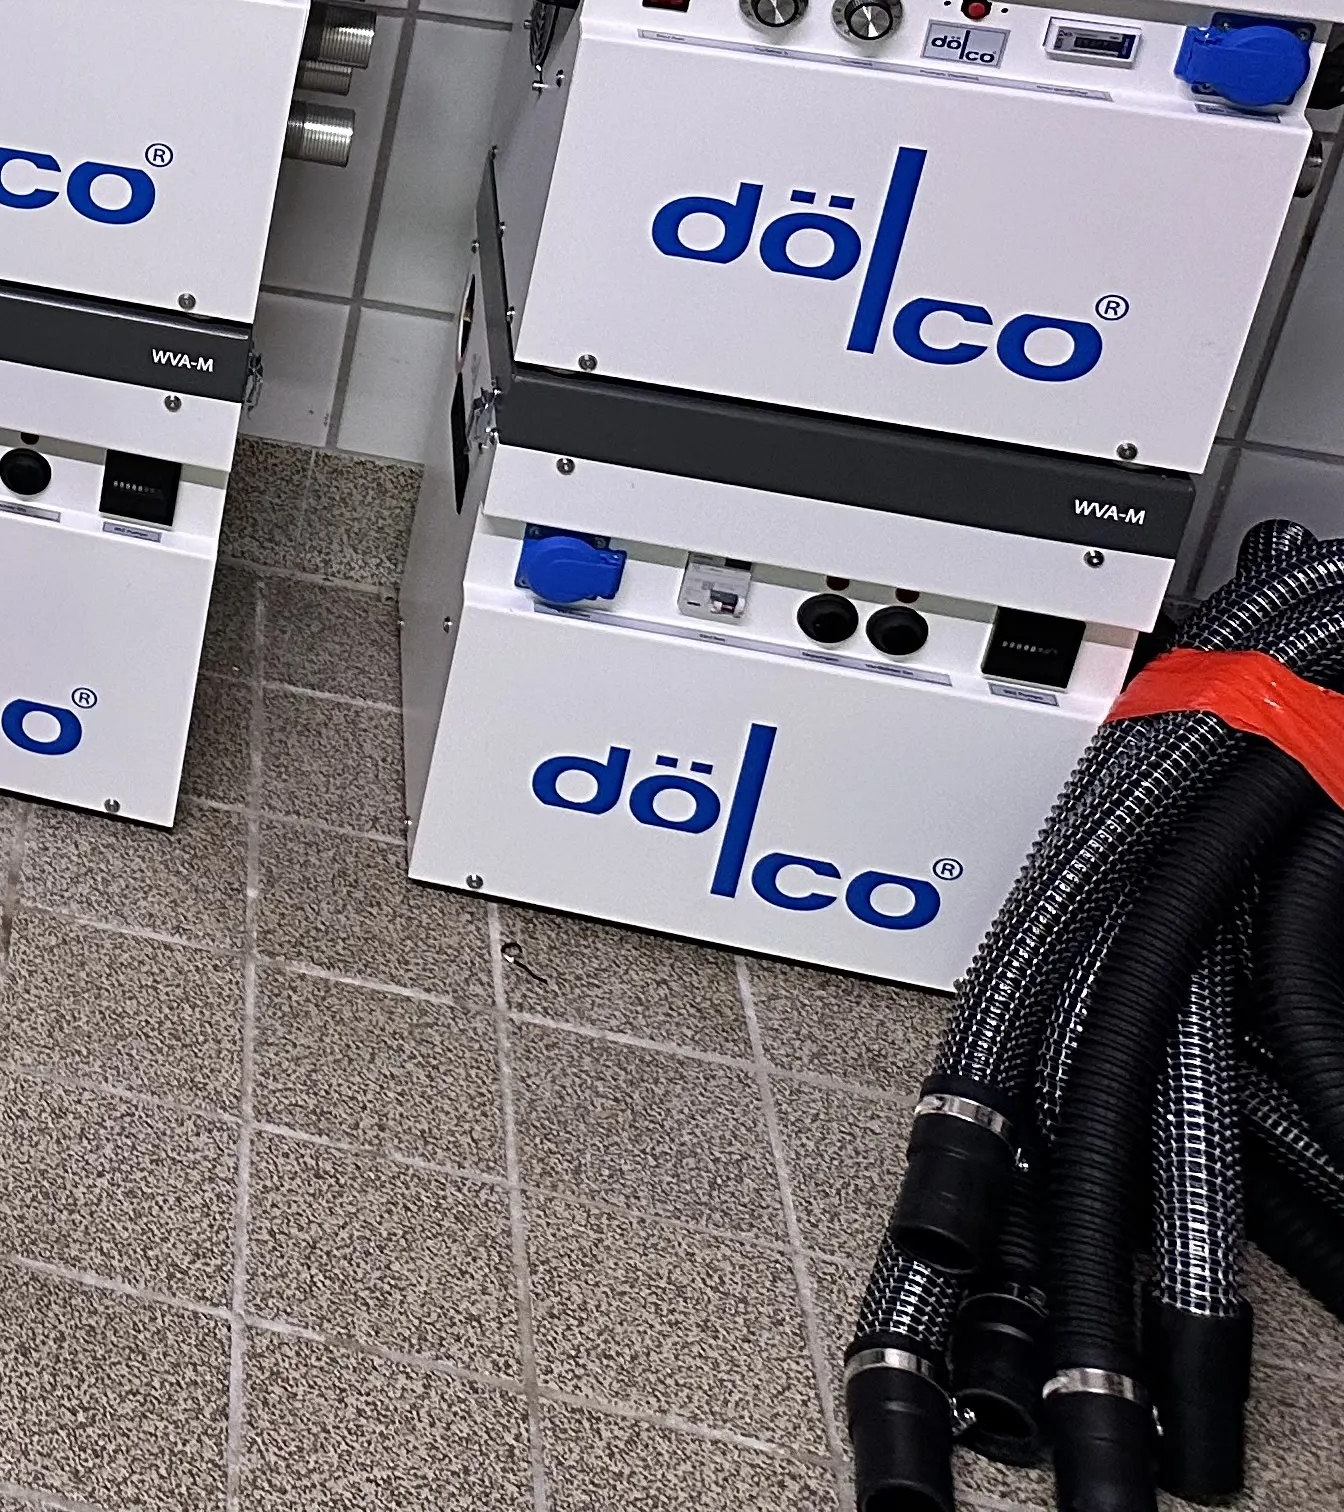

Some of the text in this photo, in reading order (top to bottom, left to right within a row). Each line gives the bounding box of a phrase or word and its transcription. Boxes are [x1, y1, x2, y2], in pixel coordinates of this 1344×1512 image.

[932, 30, 996, 63] dölco
[652, 147, 1102, 382] dölco
[153, 349, 213, 372] WVA-M
[1075, 500, 1145, 524] WVA-M
[533, 724, 941, 930] dölco
